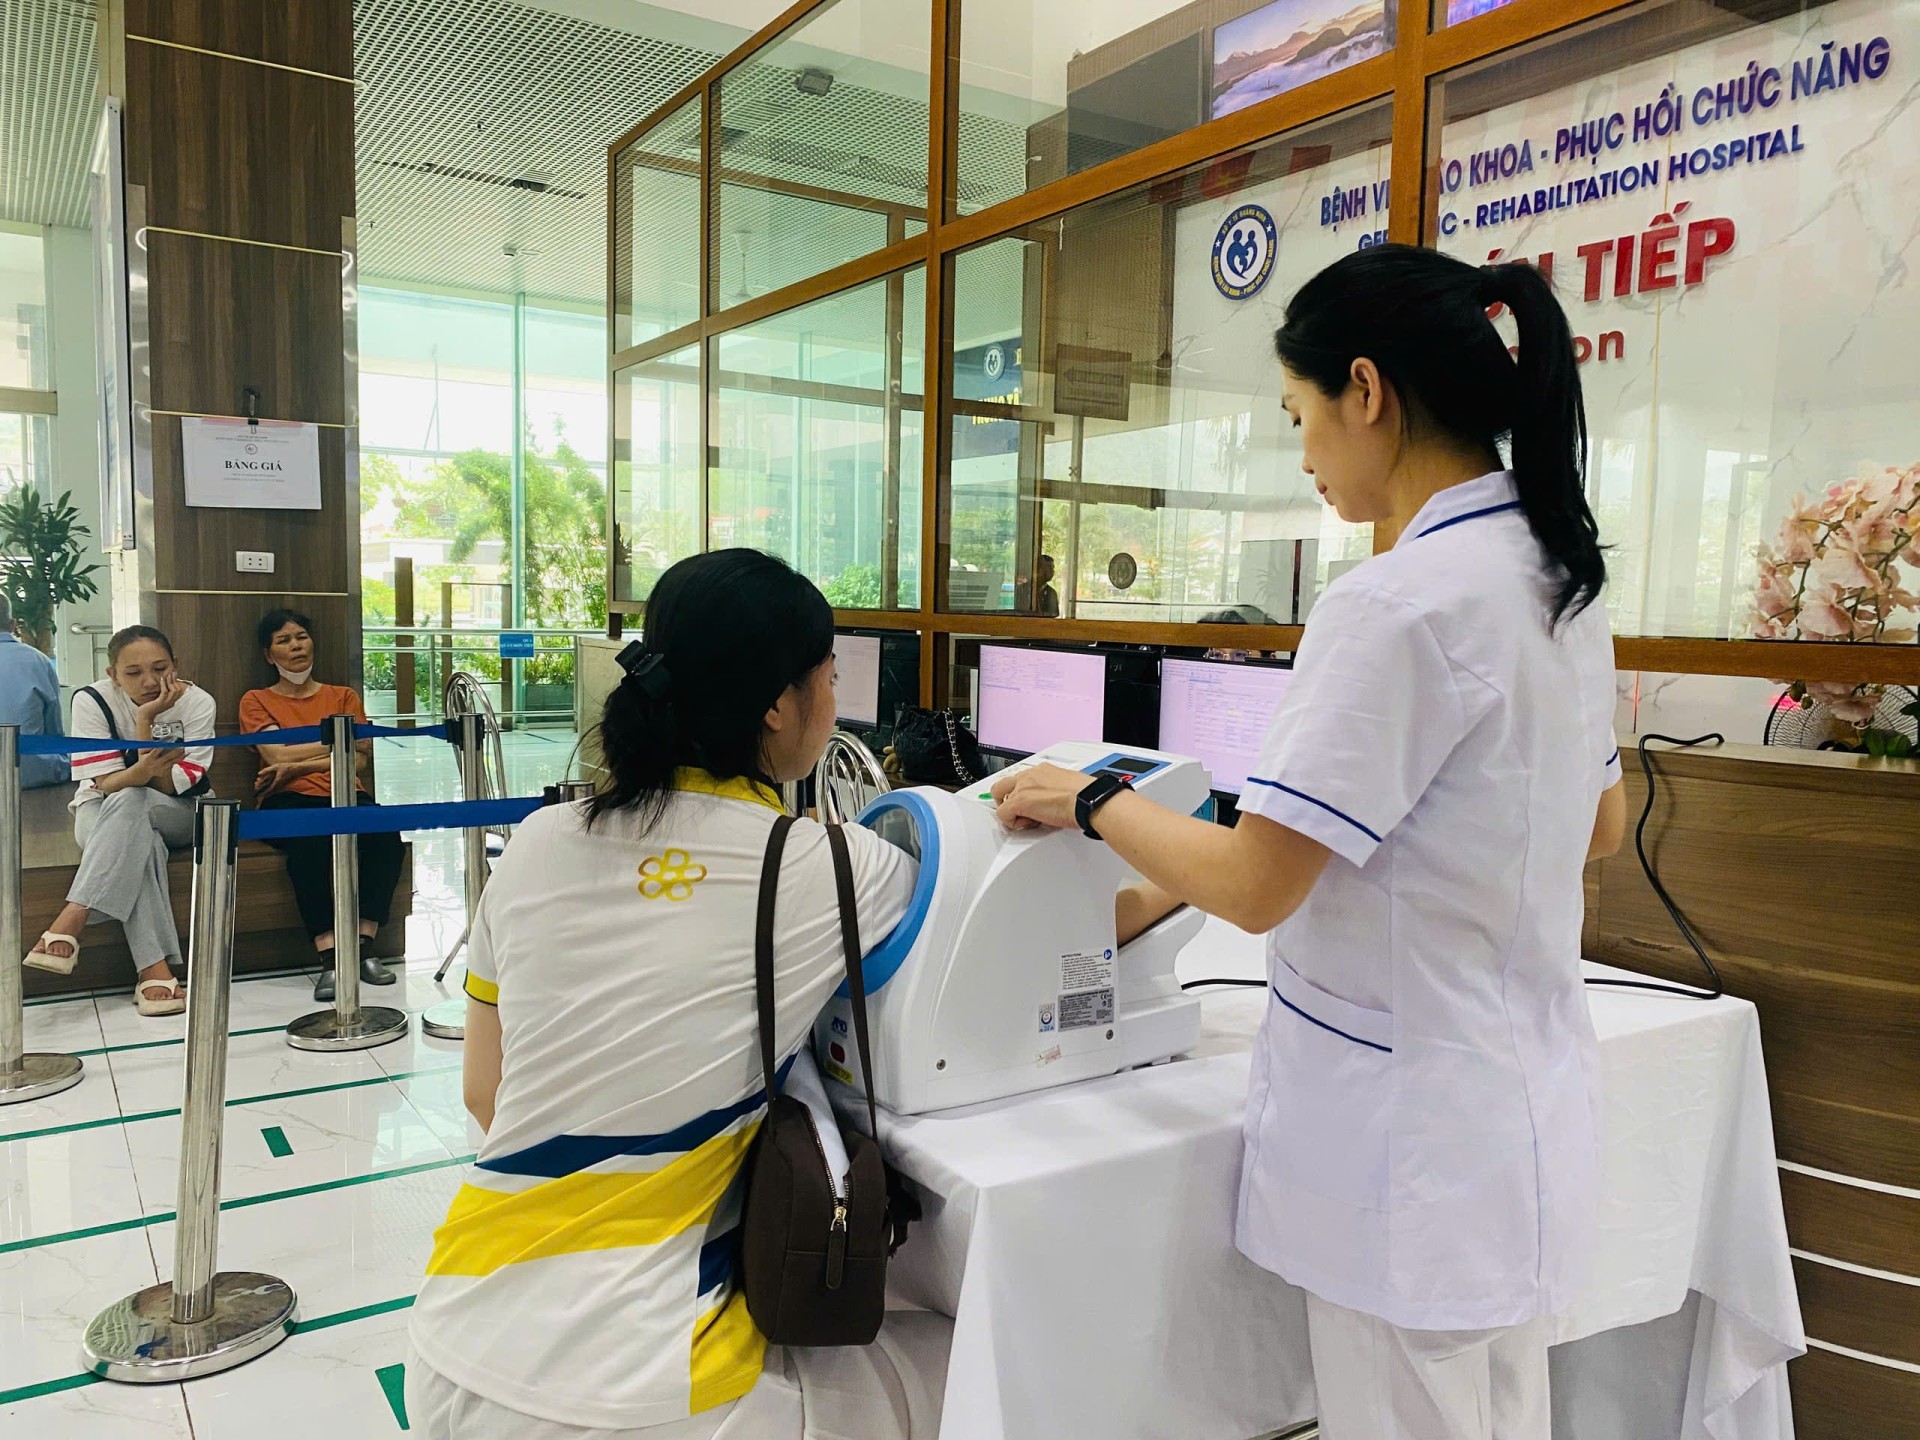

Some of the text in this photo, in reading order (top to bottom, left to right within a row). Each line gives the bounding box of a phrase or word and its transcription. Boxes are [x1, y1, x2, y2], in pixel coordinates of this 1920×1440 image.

[1321, 186, 1366, 232] BỆNH
[1373, 179, 1391, 211] VI
[1469, 139, 1534, 187] KHOA
[1555, 112, 1625, 165] PHỤC
[1632, 81, 1683, 143] HỒI
[1692, 60, 1781, 126] CHỨC
[1791, 36, 1891, 100] NĂNG
[1475, 159, 1659, 228] REHABILITATION
[1668, 124, 1805, 181] HOSPITAL
[1576, 200, 1737, 302] TIẾP
